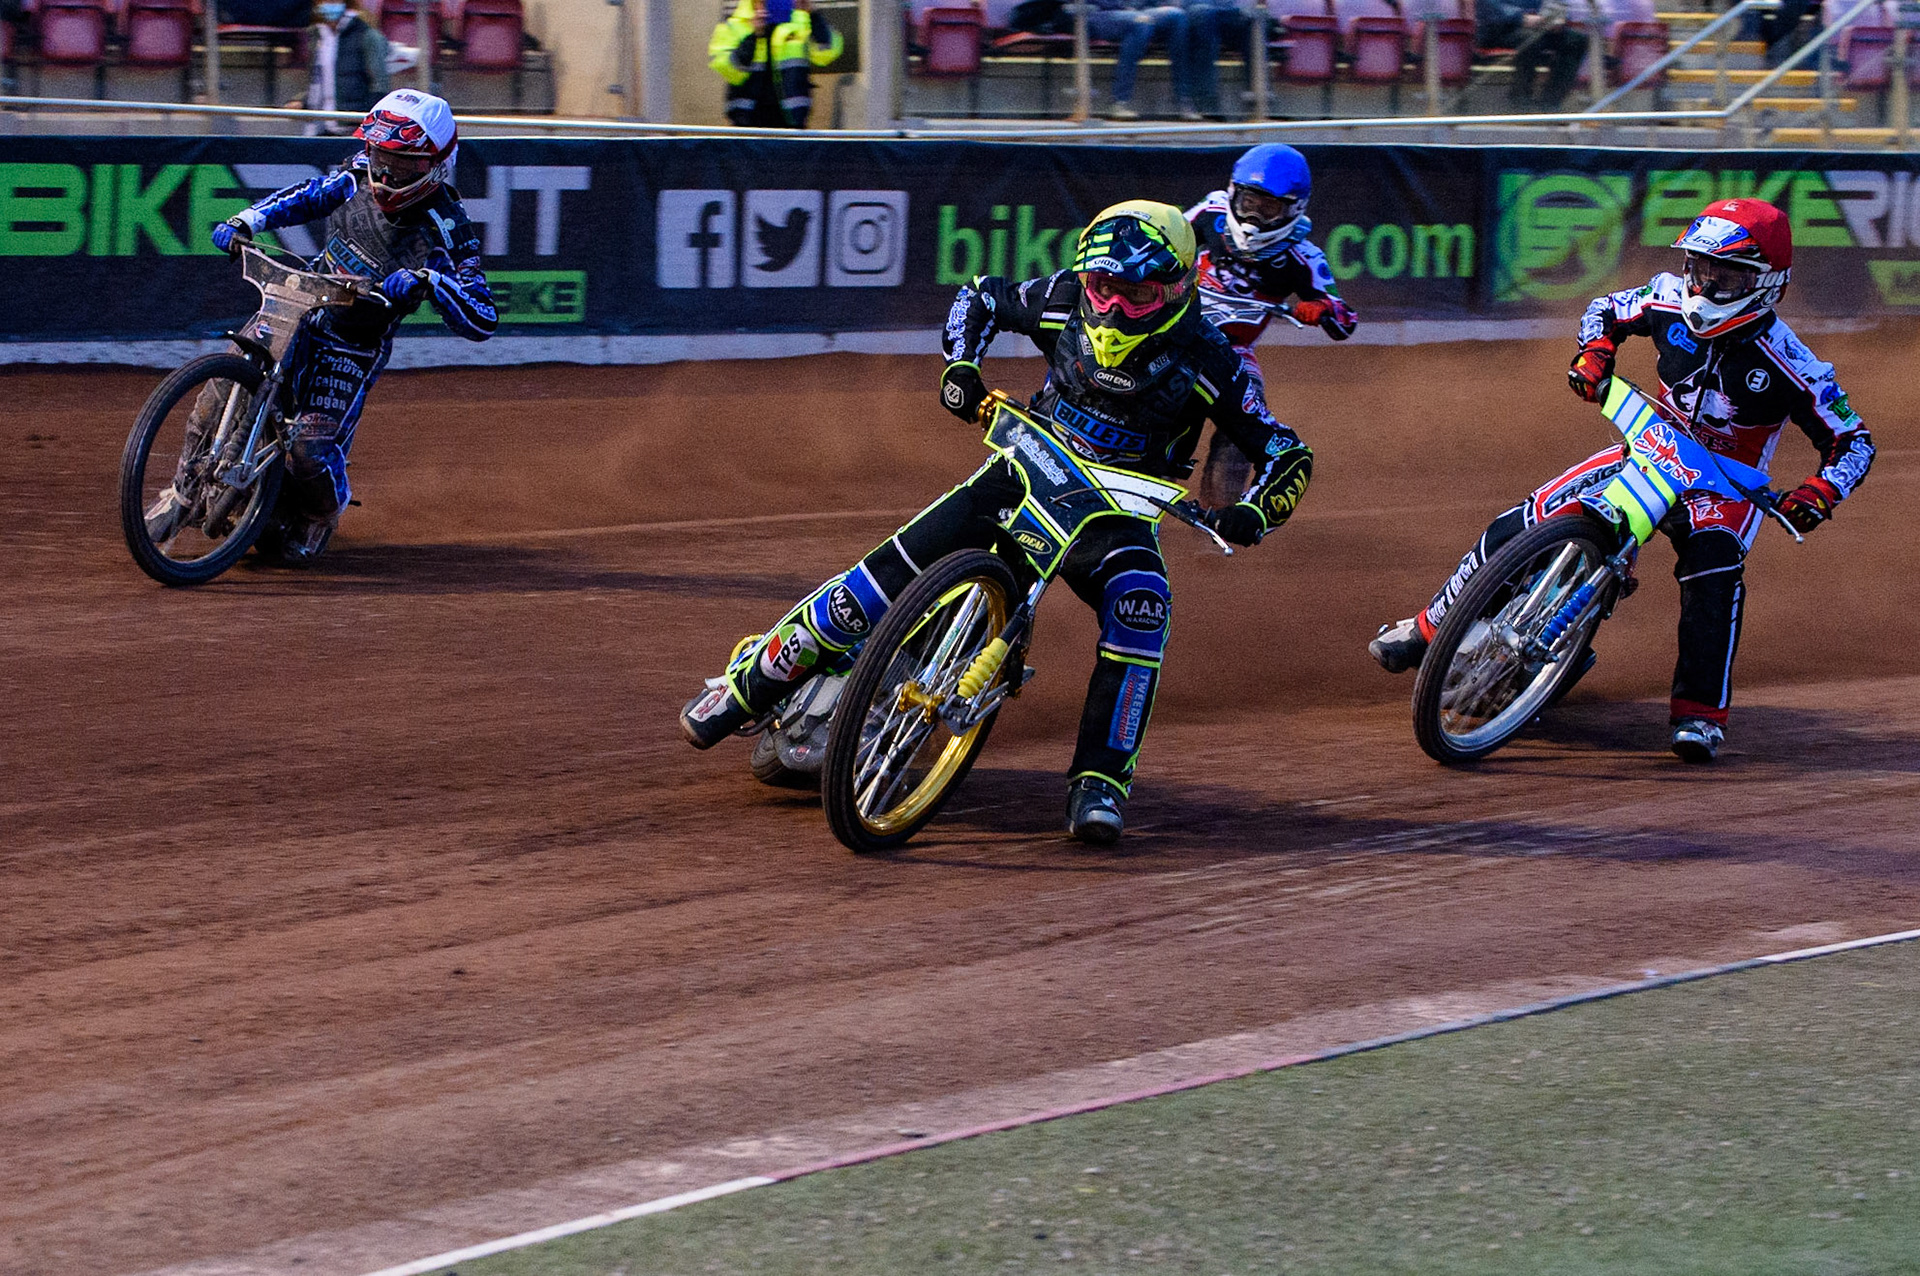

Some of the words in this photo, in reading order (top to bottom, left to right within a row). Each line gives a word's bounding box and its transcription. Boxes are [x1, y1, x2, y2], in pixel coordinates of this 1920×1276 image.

[315, 375, 353, 393] Cairns
[1096, 371, 1132, 387] ORTEMA
[310, 393, 346, 411] Logan
[1056, 403, 1144, 448] BULLETS
[1018, 533, 1046, 552] IDEAL
[1118, 600, 1166, 619] W.A.R.
[773, 633, 799, 675] TPS
[1123, 672, 1151, 749] TWEEDSIDE
